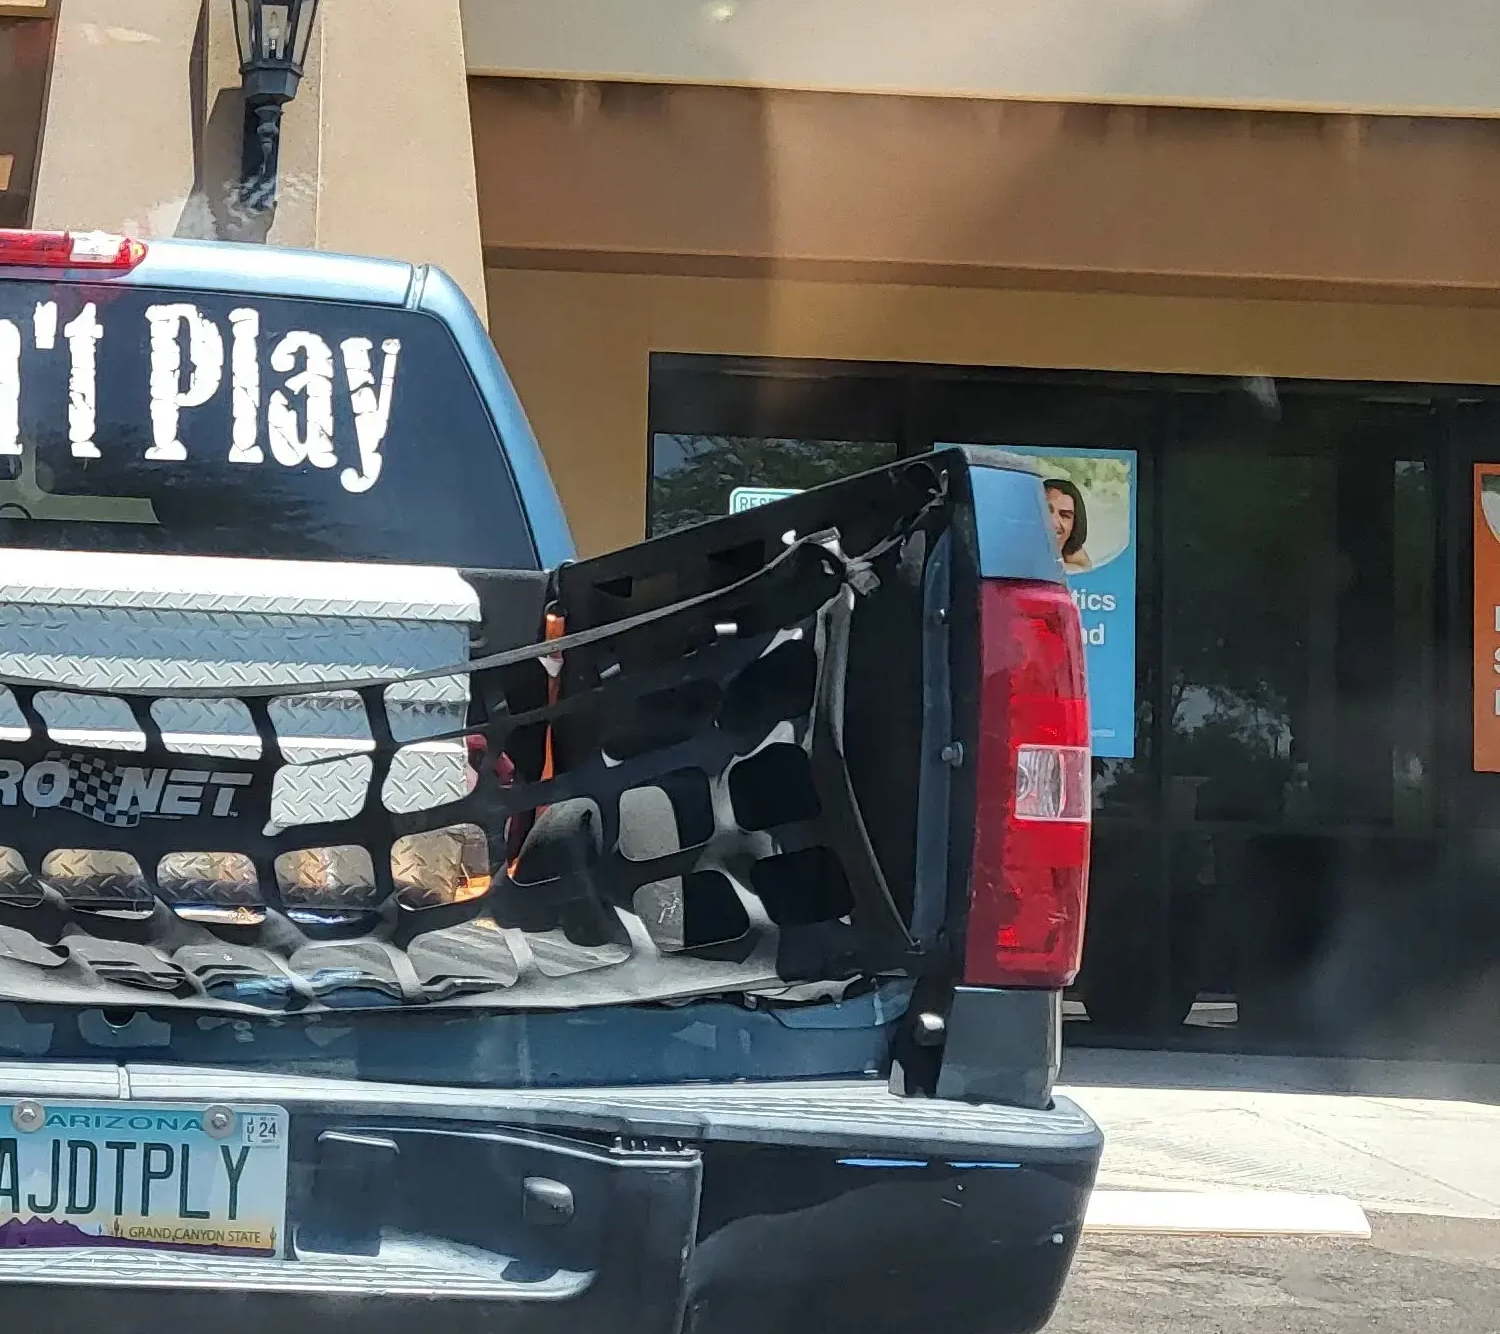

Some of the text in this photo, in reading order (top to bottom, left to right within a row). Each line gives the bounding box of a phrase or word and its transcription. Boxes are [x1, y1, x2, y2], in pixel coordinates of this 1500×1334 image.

[145, 303, 402, 493] Play
[115, 765, 254, 817] NET
[45, 1114, 205, 1132] ARIZONA
[259, 1121, 277, 1138] 24
[129, 1226, 261, 1244] GRAND CANYON STATE
